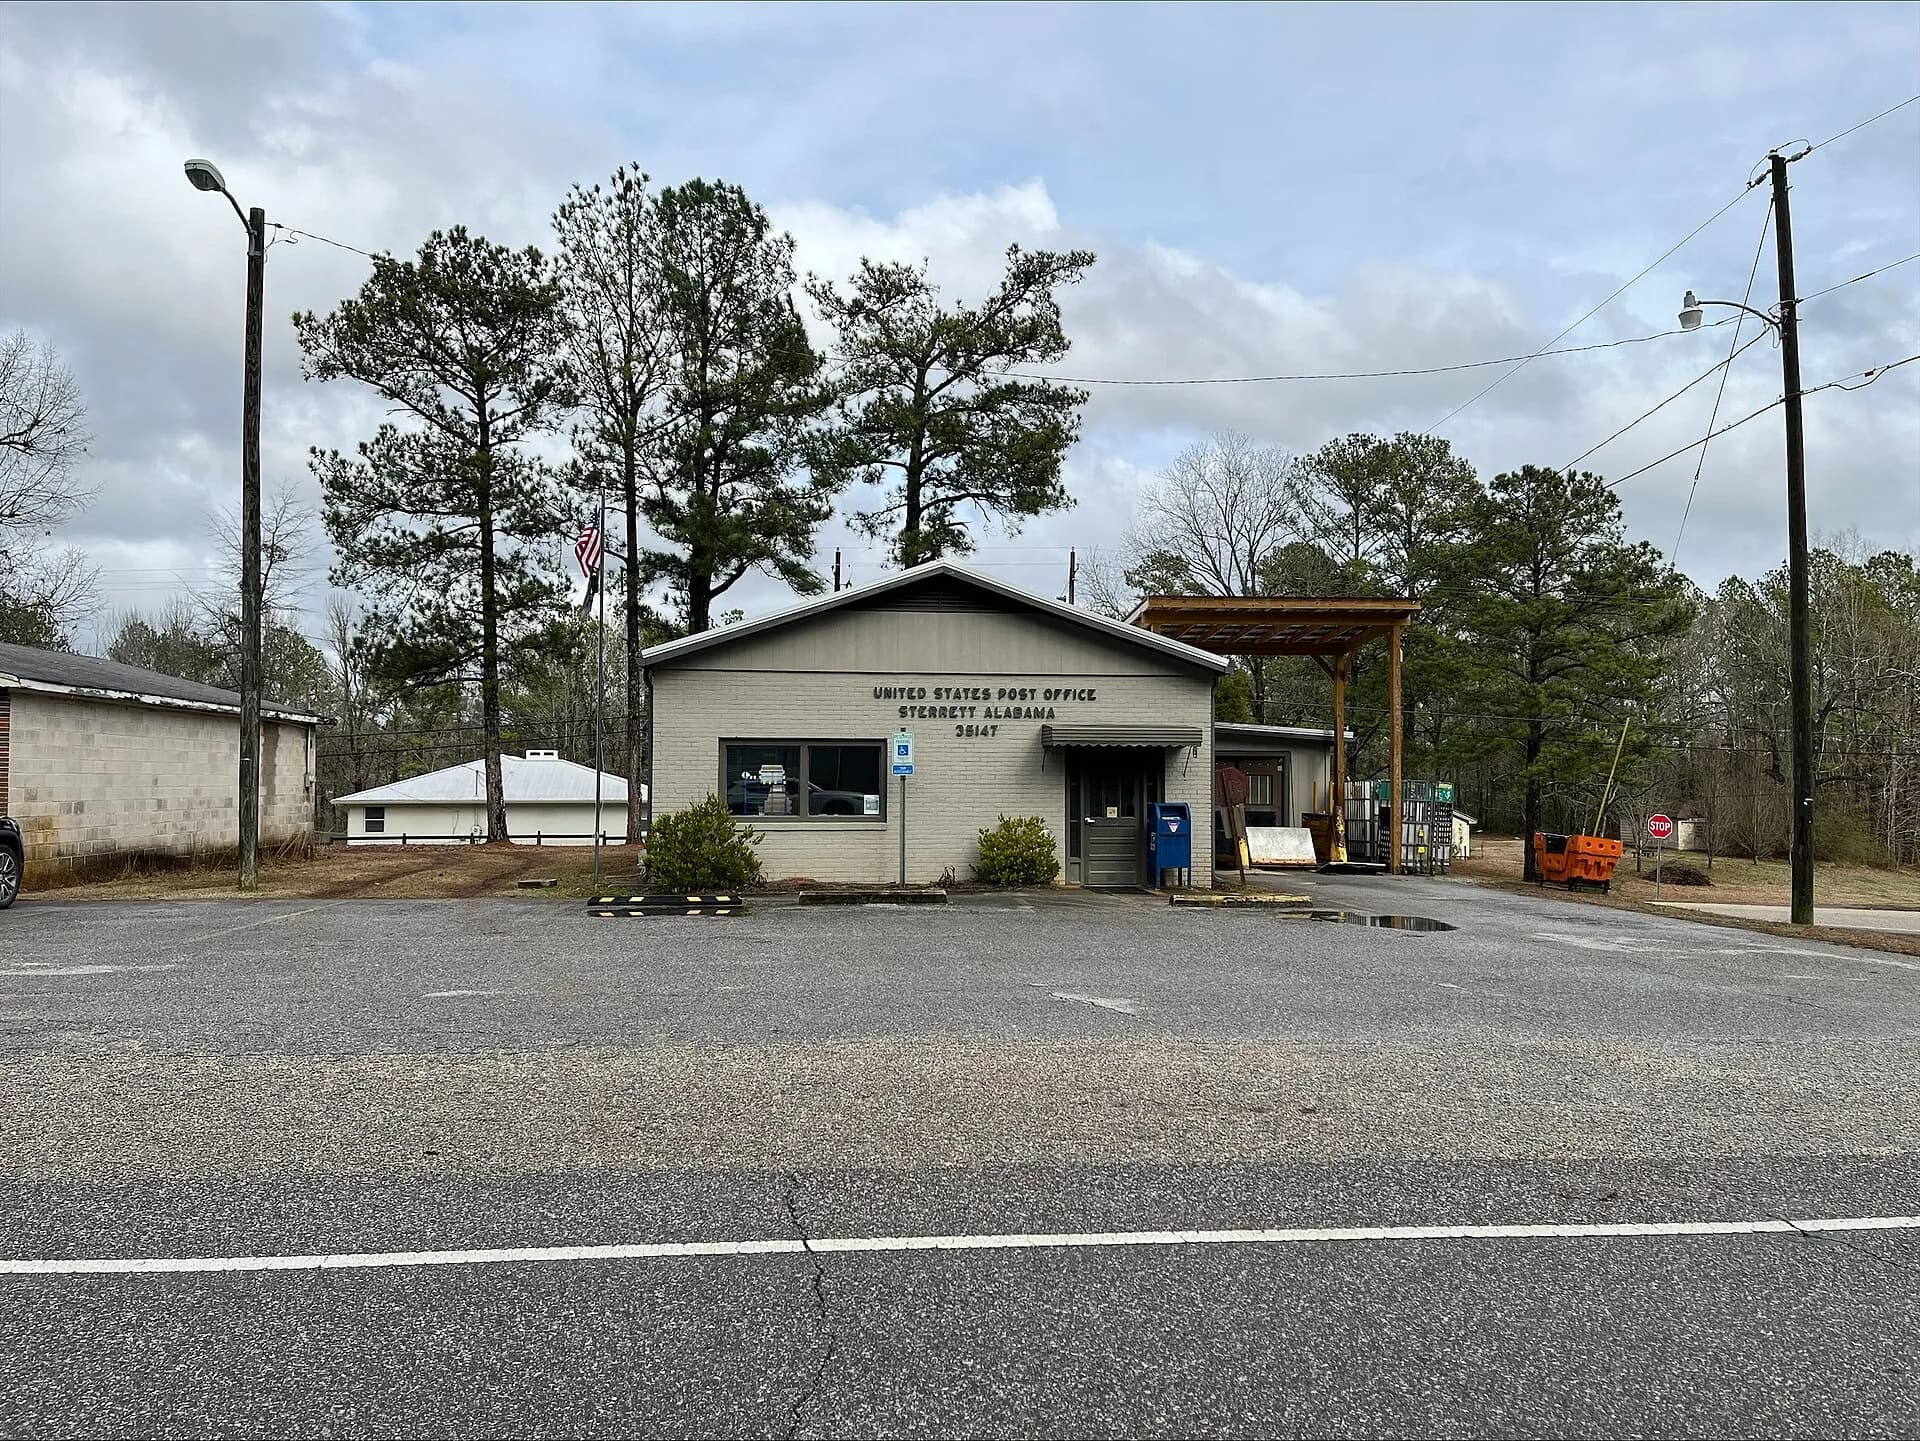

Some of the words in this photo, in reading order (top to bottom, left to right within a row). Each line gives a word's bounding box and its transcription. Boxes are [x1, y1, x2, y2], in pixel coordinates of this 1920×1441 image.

[873, 687, 927, 700] UNITED
[933, 687, 992, 700] STATES
[998, 688, 1037, 701] POST
[1043, 688, 1097, 701] OFFICE
[898, 706, 977, 719] STERRETT
[984, 707, 1056, 719] ALABAMA
[955, 724, 998, 737] 35147
[1649, 820, 1671, 832] STOP
